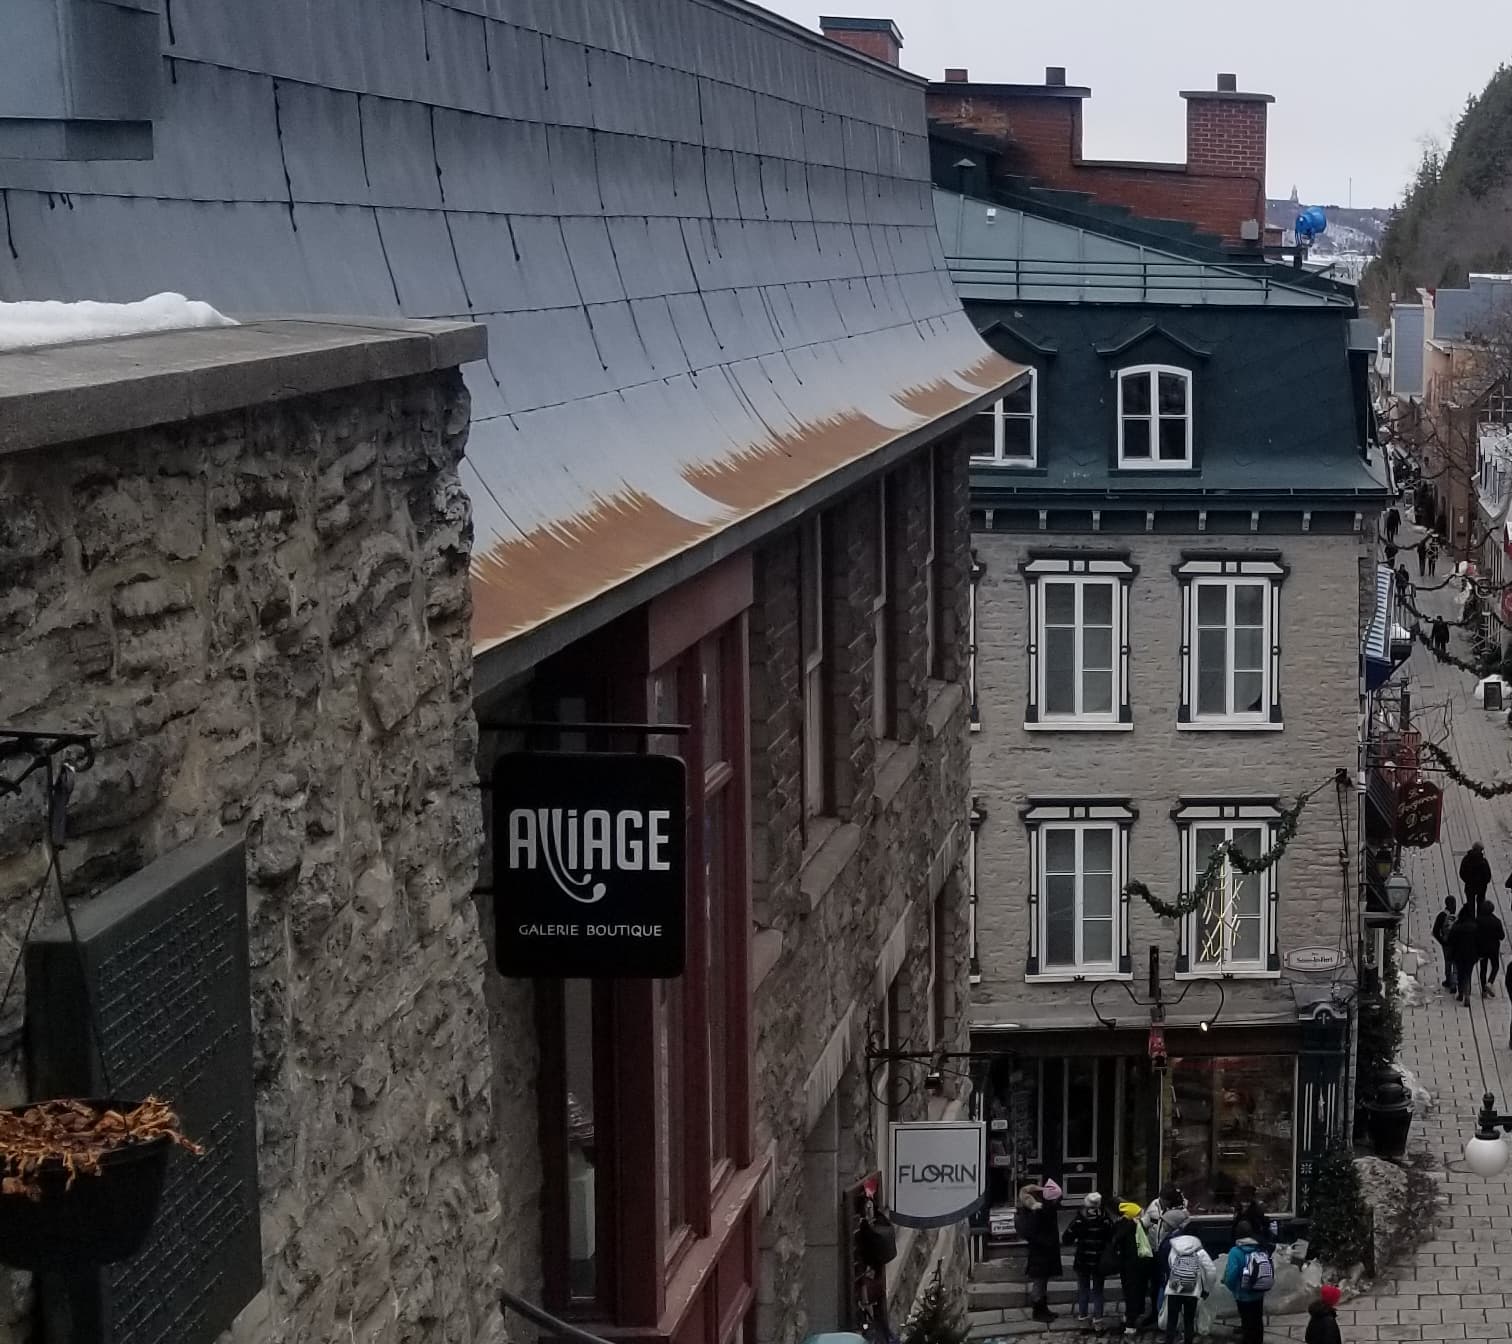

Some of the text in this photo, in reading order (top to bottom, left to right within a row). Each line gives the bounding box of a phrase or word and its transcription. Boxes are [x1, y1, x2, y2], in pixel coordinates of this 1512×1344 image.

[518, 923, 662, 937] GALERIE BOUTIQUE
[898, 1163, 977, 1184] FLORIN
